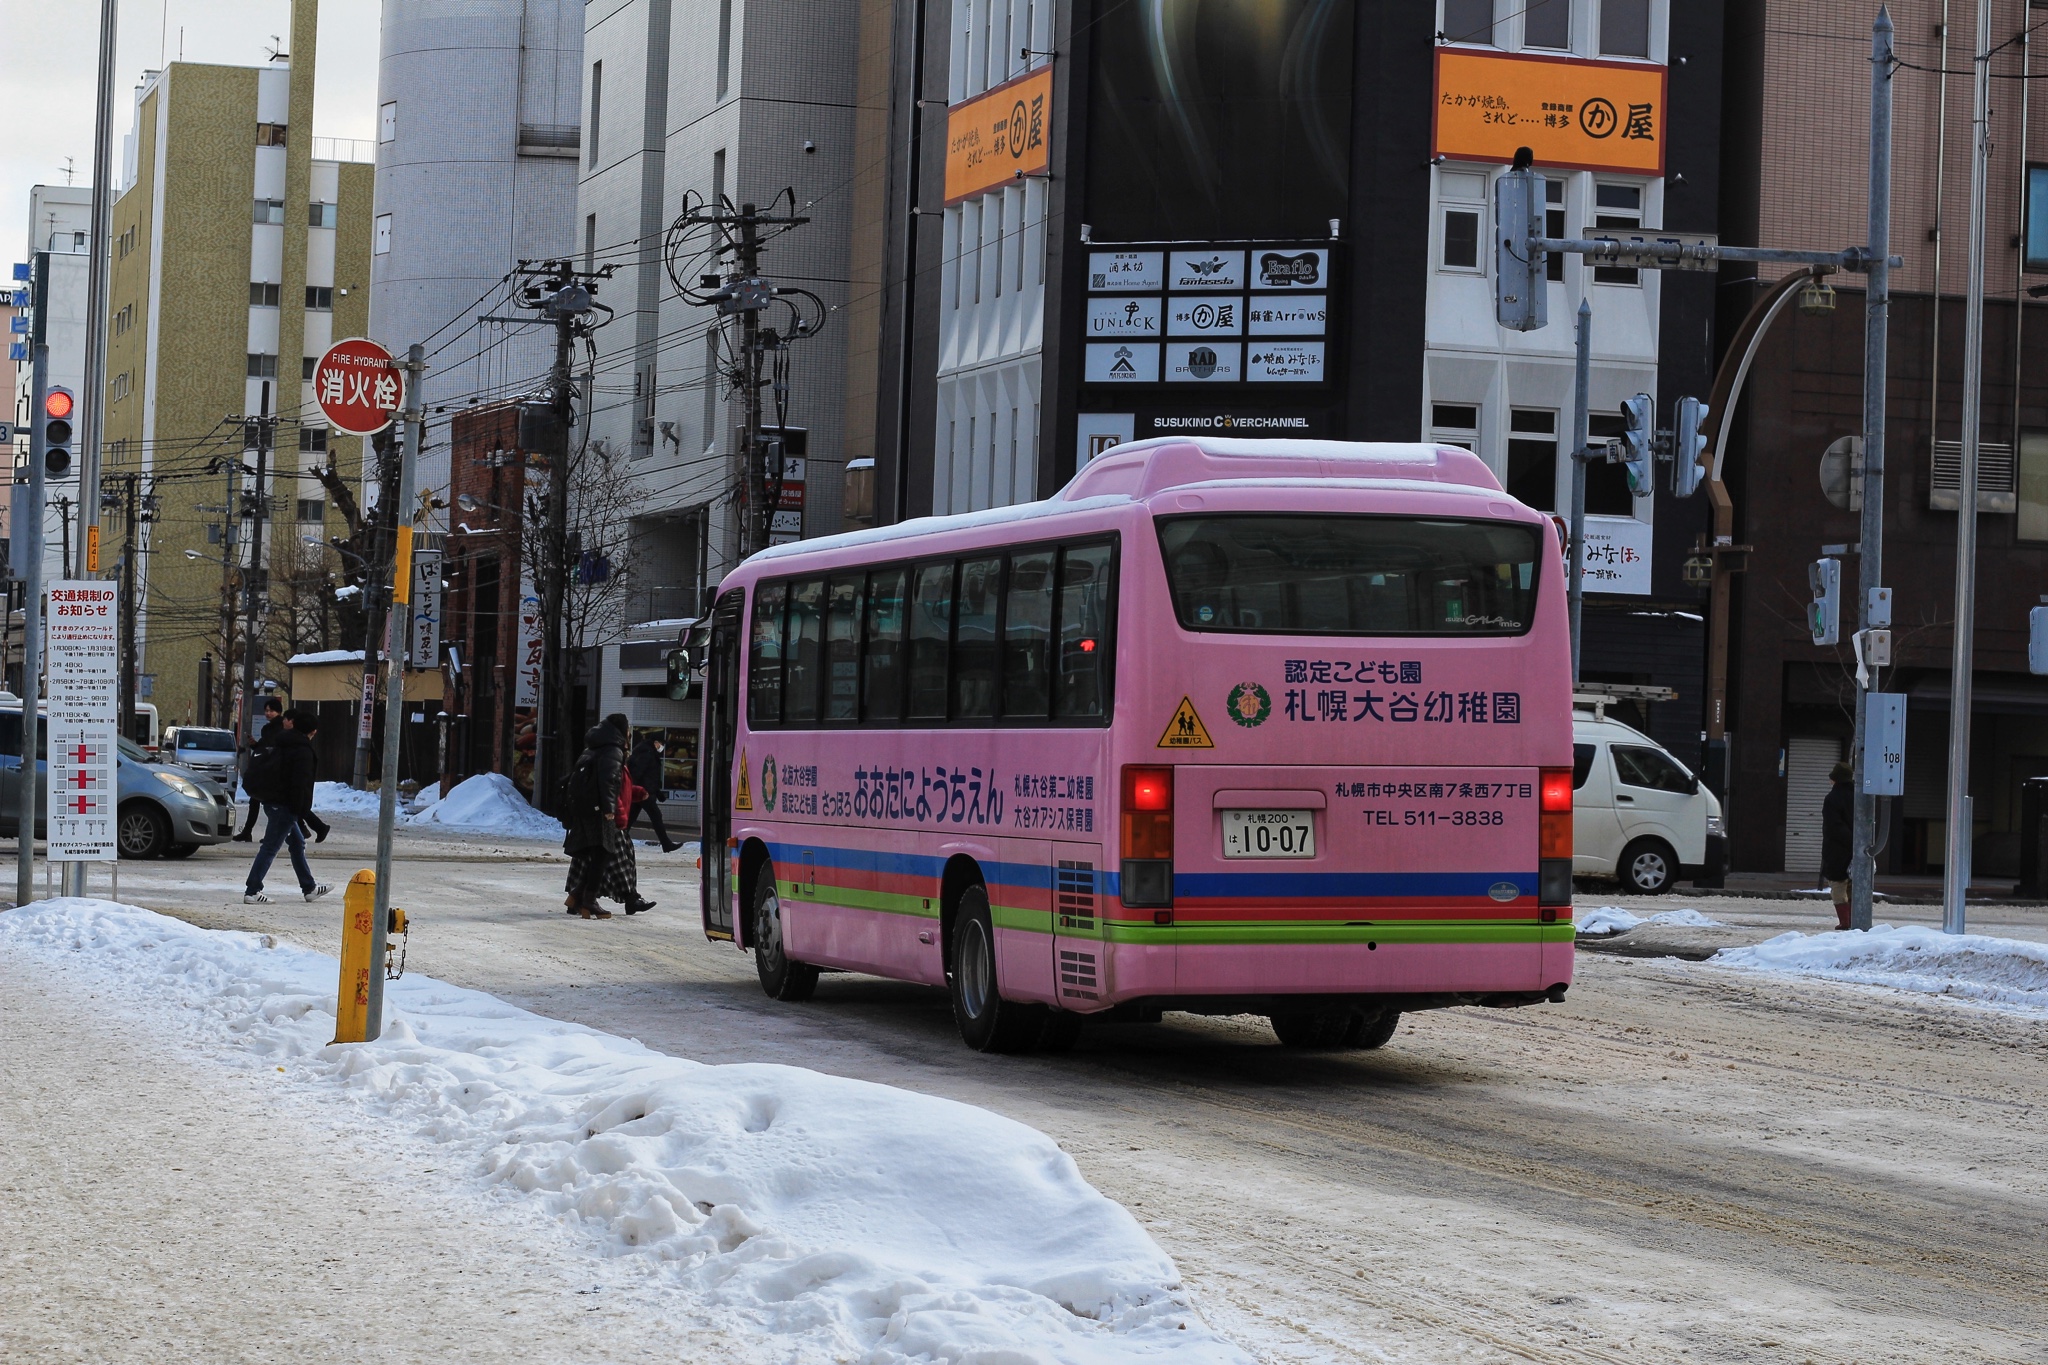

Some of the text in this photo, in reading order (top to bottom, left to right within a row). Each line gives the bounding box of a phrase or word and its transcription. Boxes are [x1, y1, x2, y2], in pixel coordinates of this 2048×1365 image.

[1543, 114, 1571, 129] 博多
[1175, 313, 1191, 321] 博多
[332, 353, 389, 369] FIRE HYDRANT
[1188, 352, 1217, 366] RAD
[321, 368, 398, 410] 消火栓
[1154, 417, 1212, 428] SUSUKINO
[1587, 544, 1640, 565] みなほっ
[51, 589, 115, 602] 交通規制の
[57, 604, 108, 616] お知らせ
[1500, 619, 1522, 627] mio
[1284, 659, 1422, 685] 認定こども園
[1284, 688, 1522, 724] 札幌大谷幼稚園
[1169, 736, 1203, 745] 幼稚園バス
[1883, 753, 1900, 763] 108
[782, 764, 818, 788] 北海大谷学園
[822, 764, 1004, 826] さっぽろ おおたにようちえん
[1014, 773, 1094, 801] 札幌大谷第二幼稚園
[1335, 782, 1532, 799] 札幌市中央区南7条西7丁目
[782, 792, 818, 816] 認定こども園
[1014, 804, 1094, 833] 大谷オアシス保育園
[1247, 813, 1289, 824] 札幌200
[1362, 810, 1400, 826] TEL
[1229, 834, 1239, 844] は
